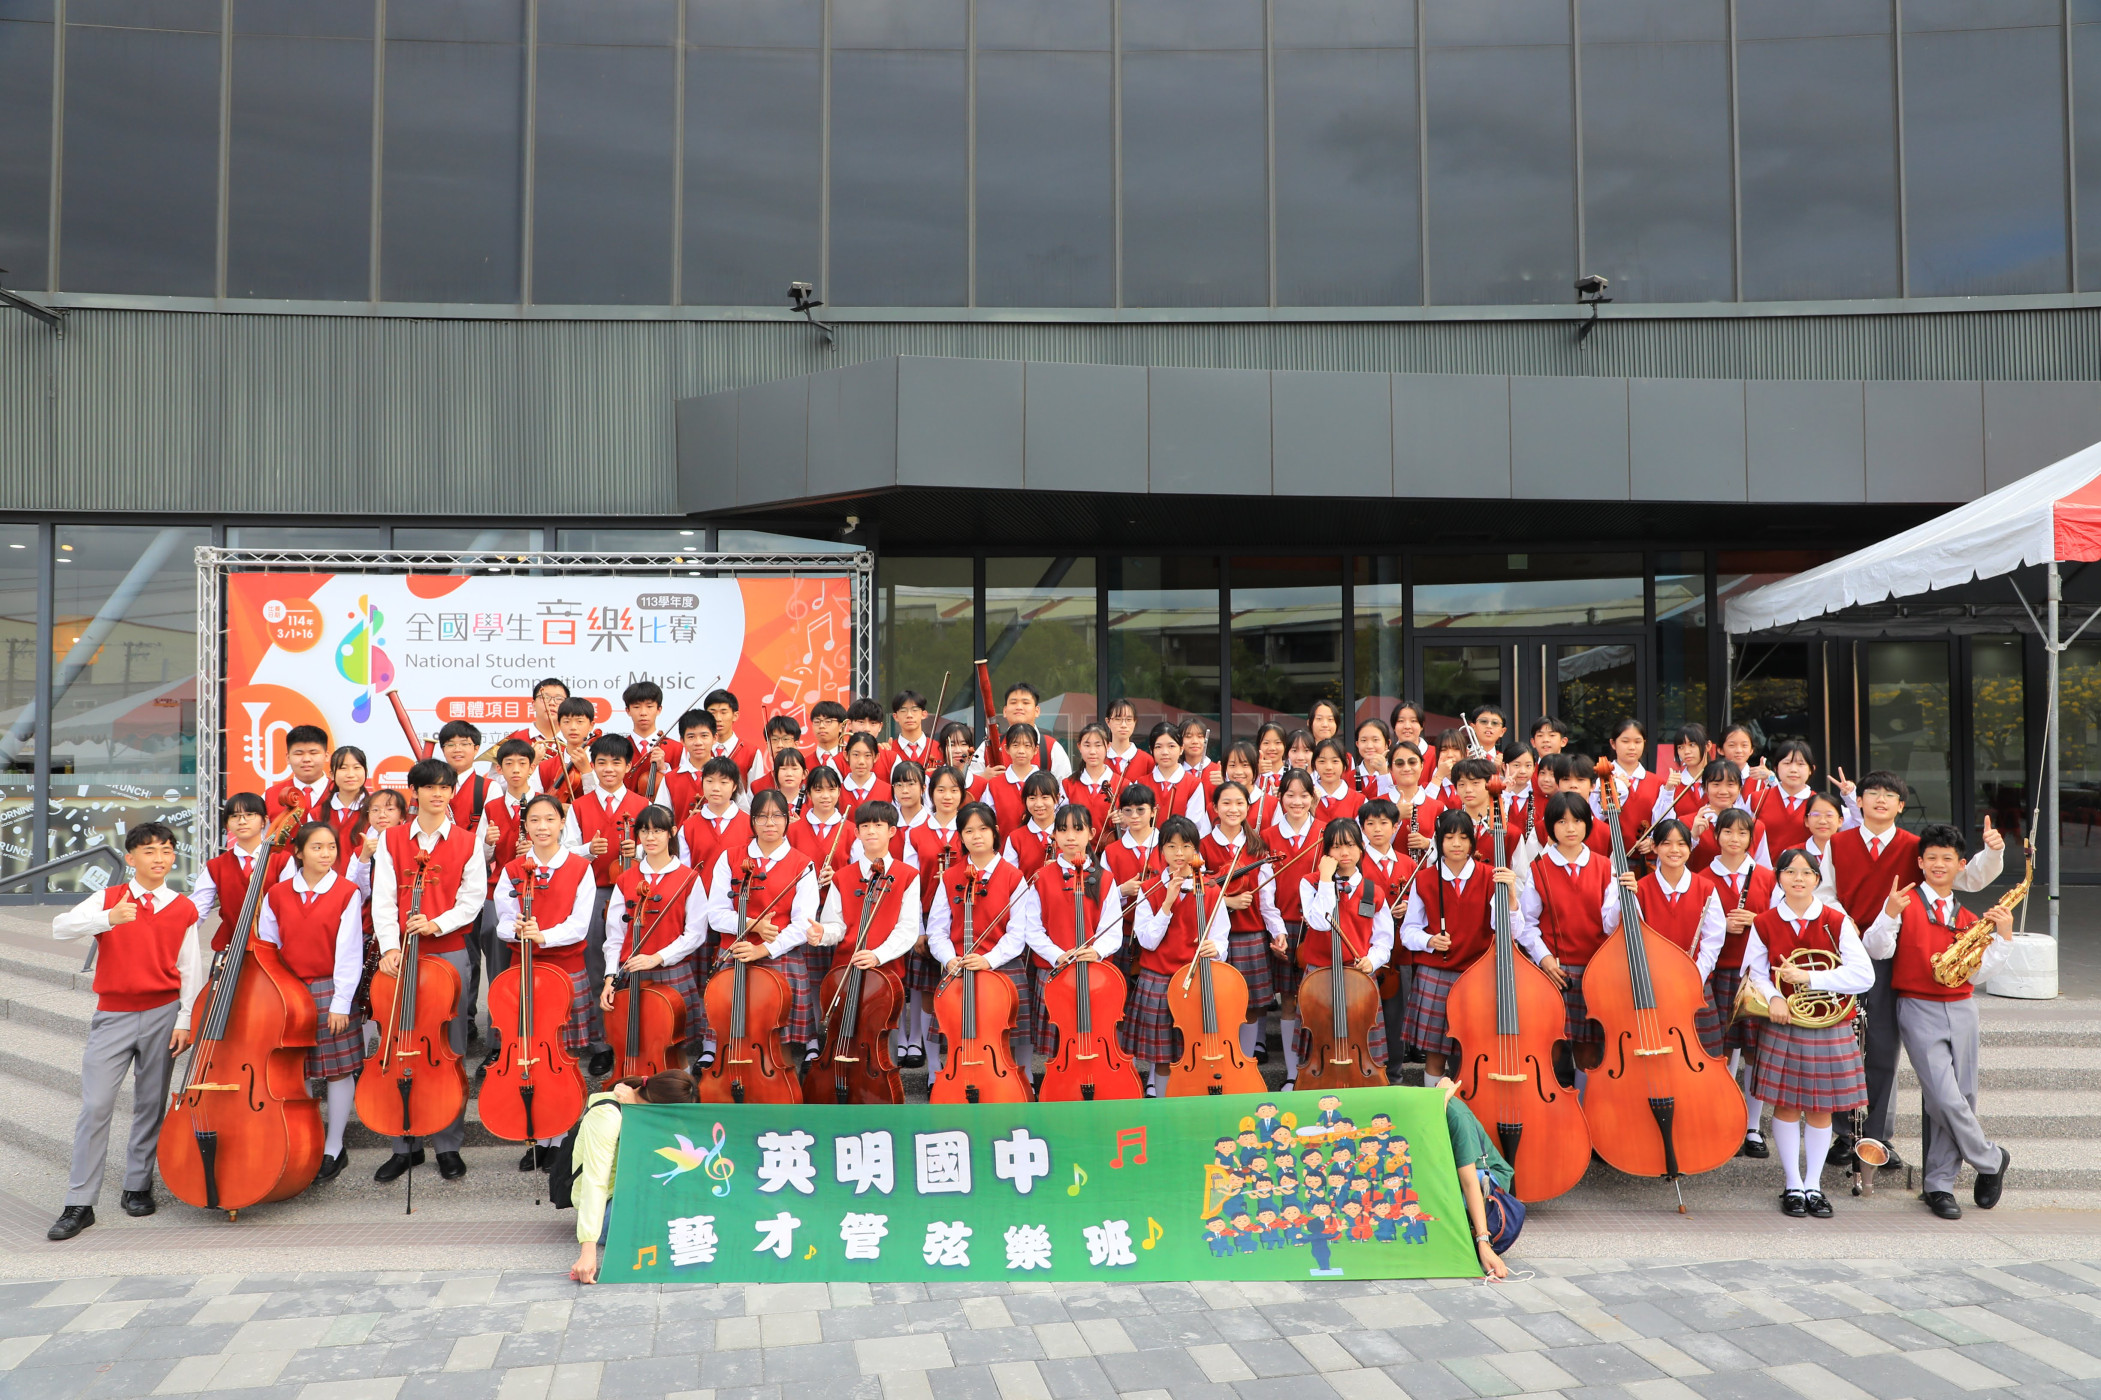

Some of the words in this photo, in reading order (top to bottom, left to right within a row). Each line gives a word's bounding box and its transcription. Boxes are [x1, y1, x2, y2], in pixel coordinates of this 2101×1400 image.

[641, 596, 694, 608] 113學年度
[406, 599, 698, 652] 全國學生音樂比賽
[405, 653, 480, 668] National
[485, 653, 556, 668] Student
[490, 674, 598, 690] Compition
[603, 675, 622, 689] of
[628, 671, 696, 690] Music
[449, 701, 519, 718] 團體項目
[105, 784, 152, 799] RUNCH!
[757, 1128, 1050, 1195] 英明國中
[667, 1211, 1137, 1270] 藝才管弦樂班
